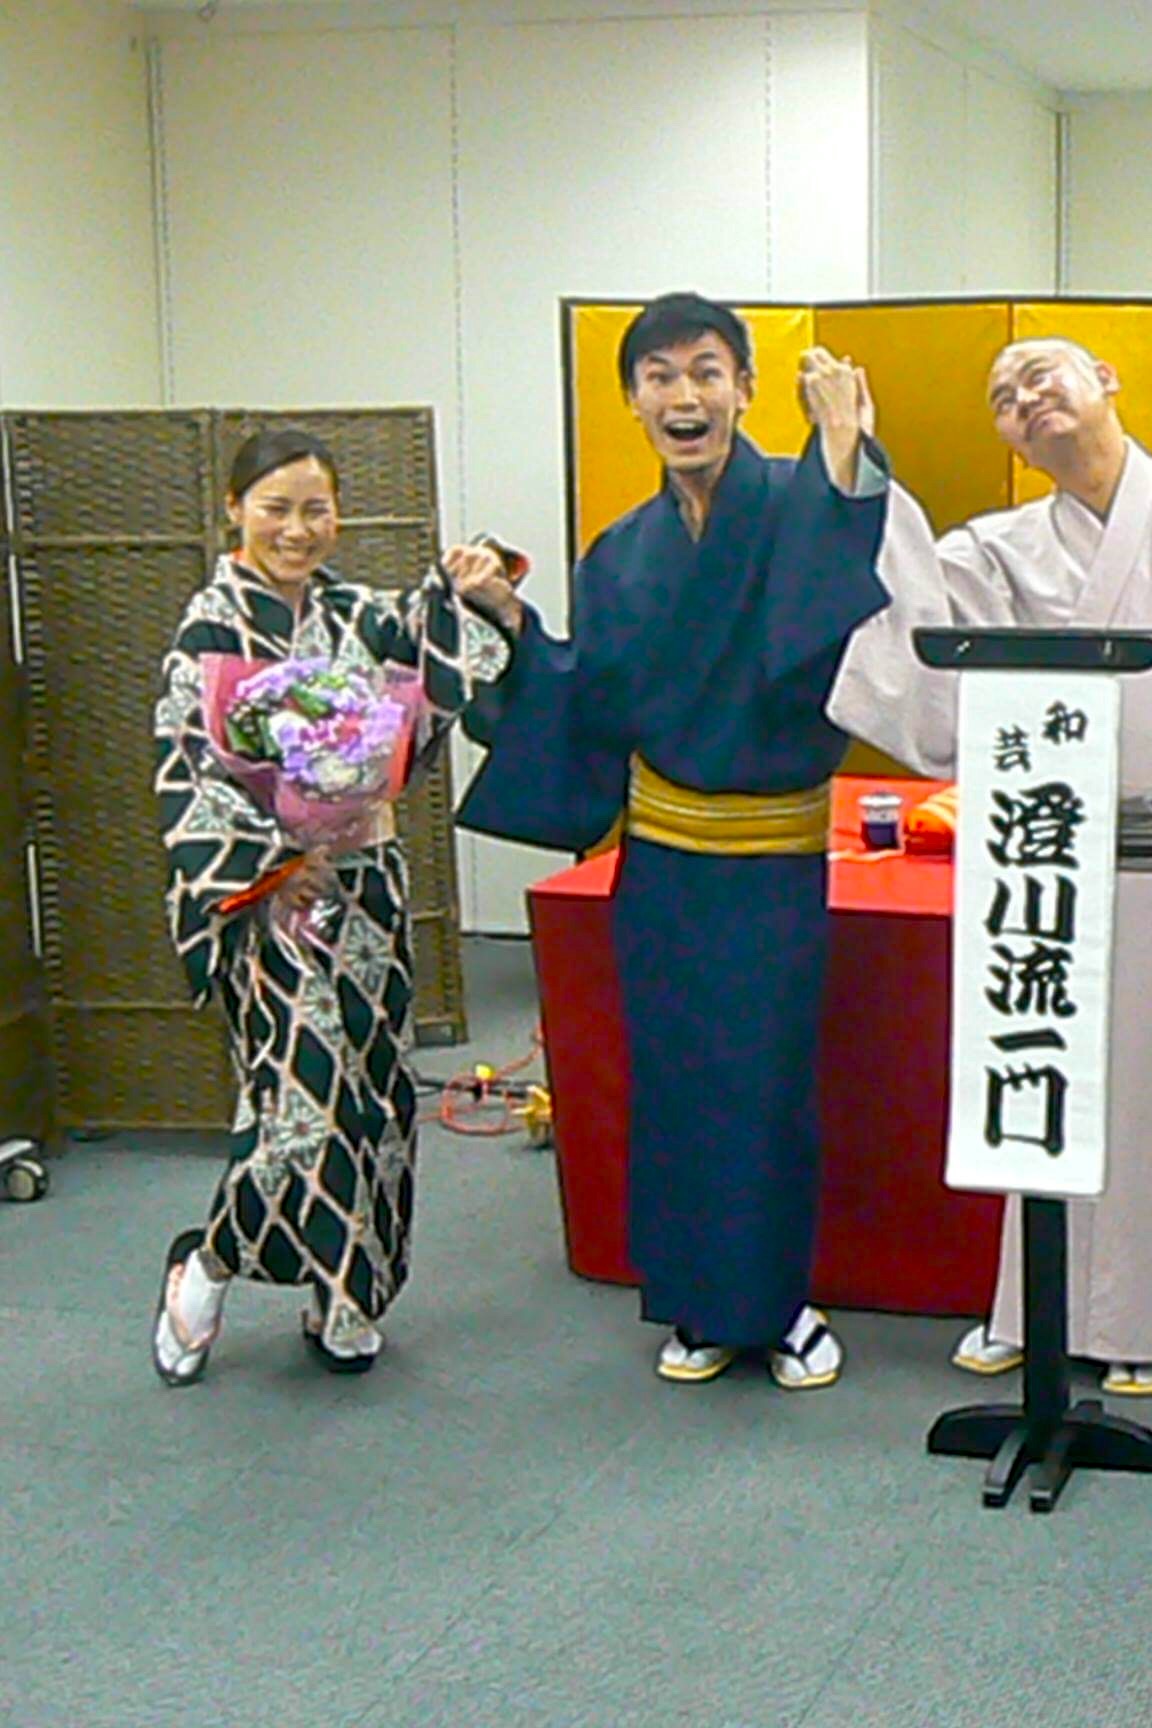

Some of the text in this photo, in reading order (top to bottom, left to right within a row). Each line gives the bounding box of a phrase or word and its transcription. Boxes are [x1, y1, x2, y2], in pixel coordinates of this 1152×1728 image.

[984, 781, 1086, 1158] 澄川流一門
